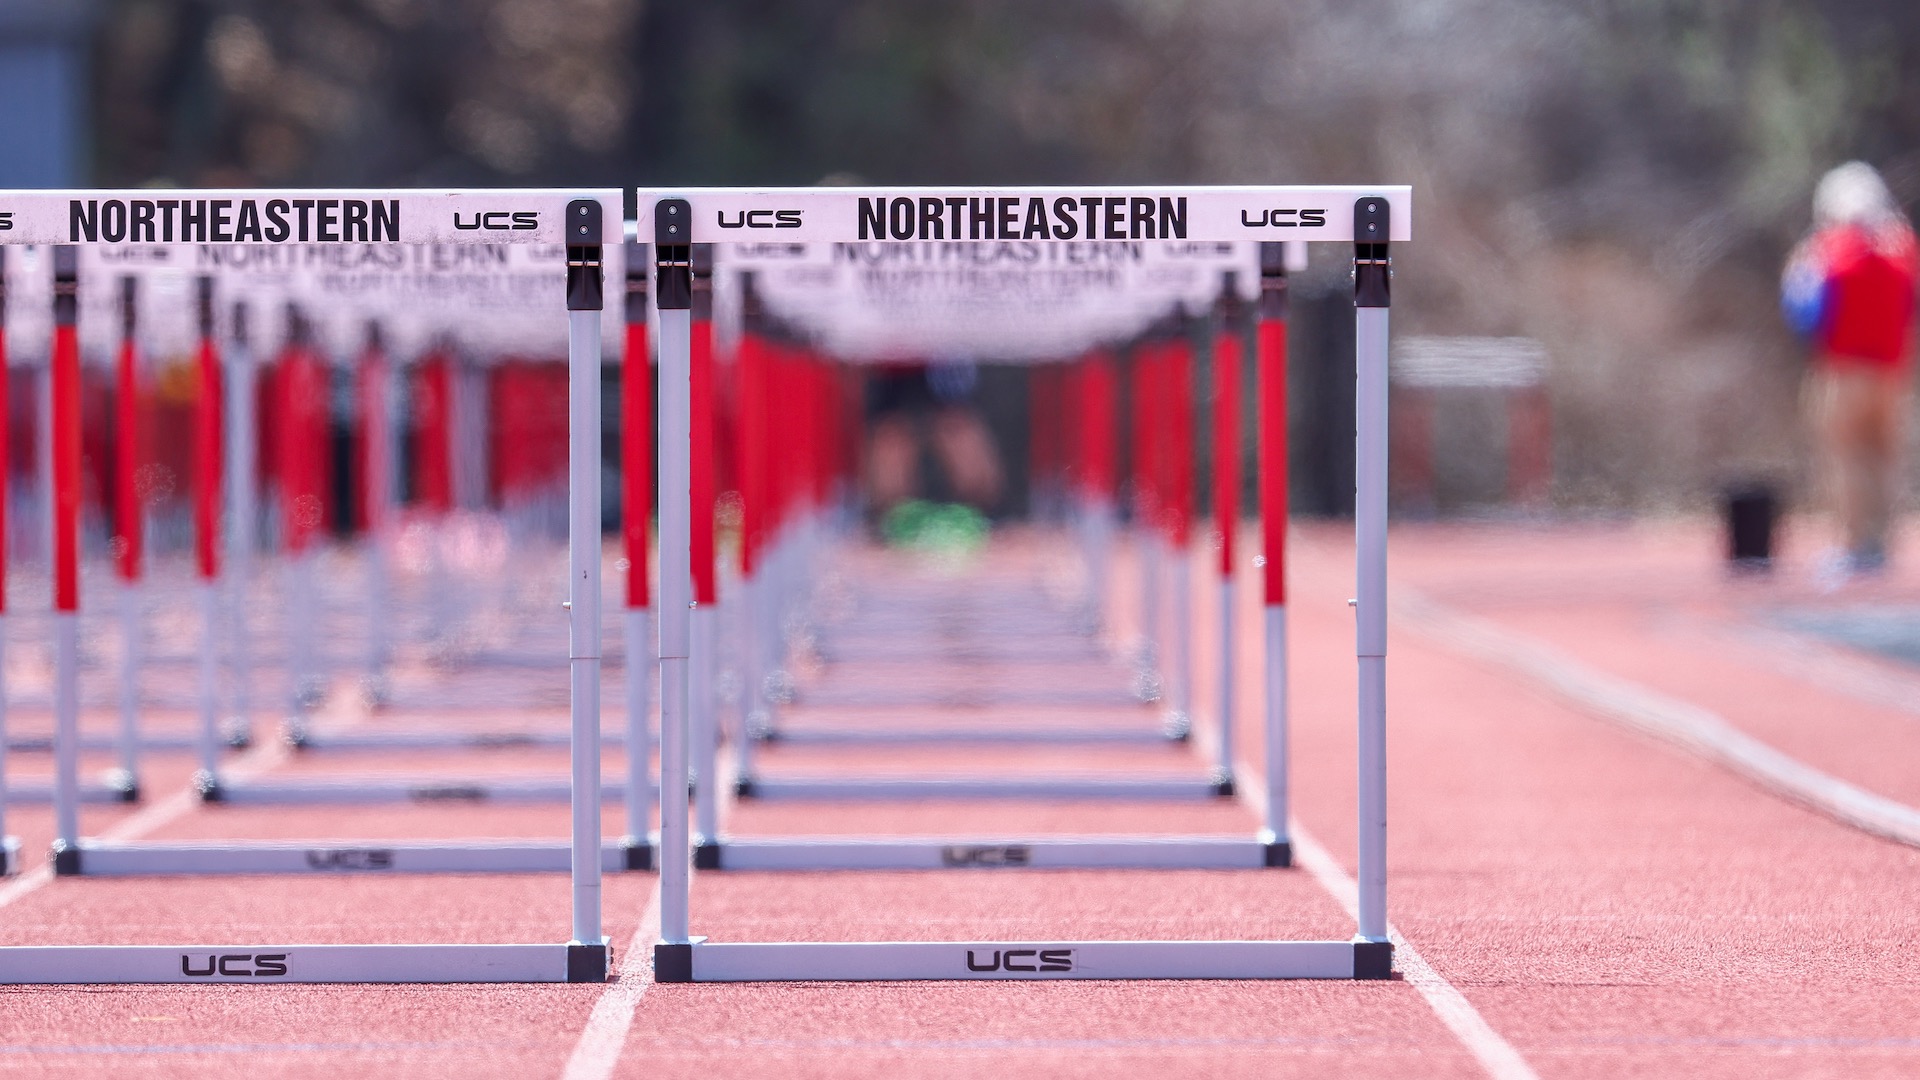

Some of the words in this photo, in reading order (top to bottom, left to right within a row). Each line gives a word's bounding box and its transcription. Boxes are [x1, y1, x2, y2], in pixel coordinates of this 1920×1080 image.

[69, 199, 400, 242] NORTHEASTERN
[454, 212, 539, 230] UCS
[717, 210, 803, 228] UCS
[857, 197, 1188, 240] NORTHEASTERN
[1241, 209, 1326, 227] UCS
[182, 954, 288, 976] UCS
[967, 950, 1073, 972] UCS
